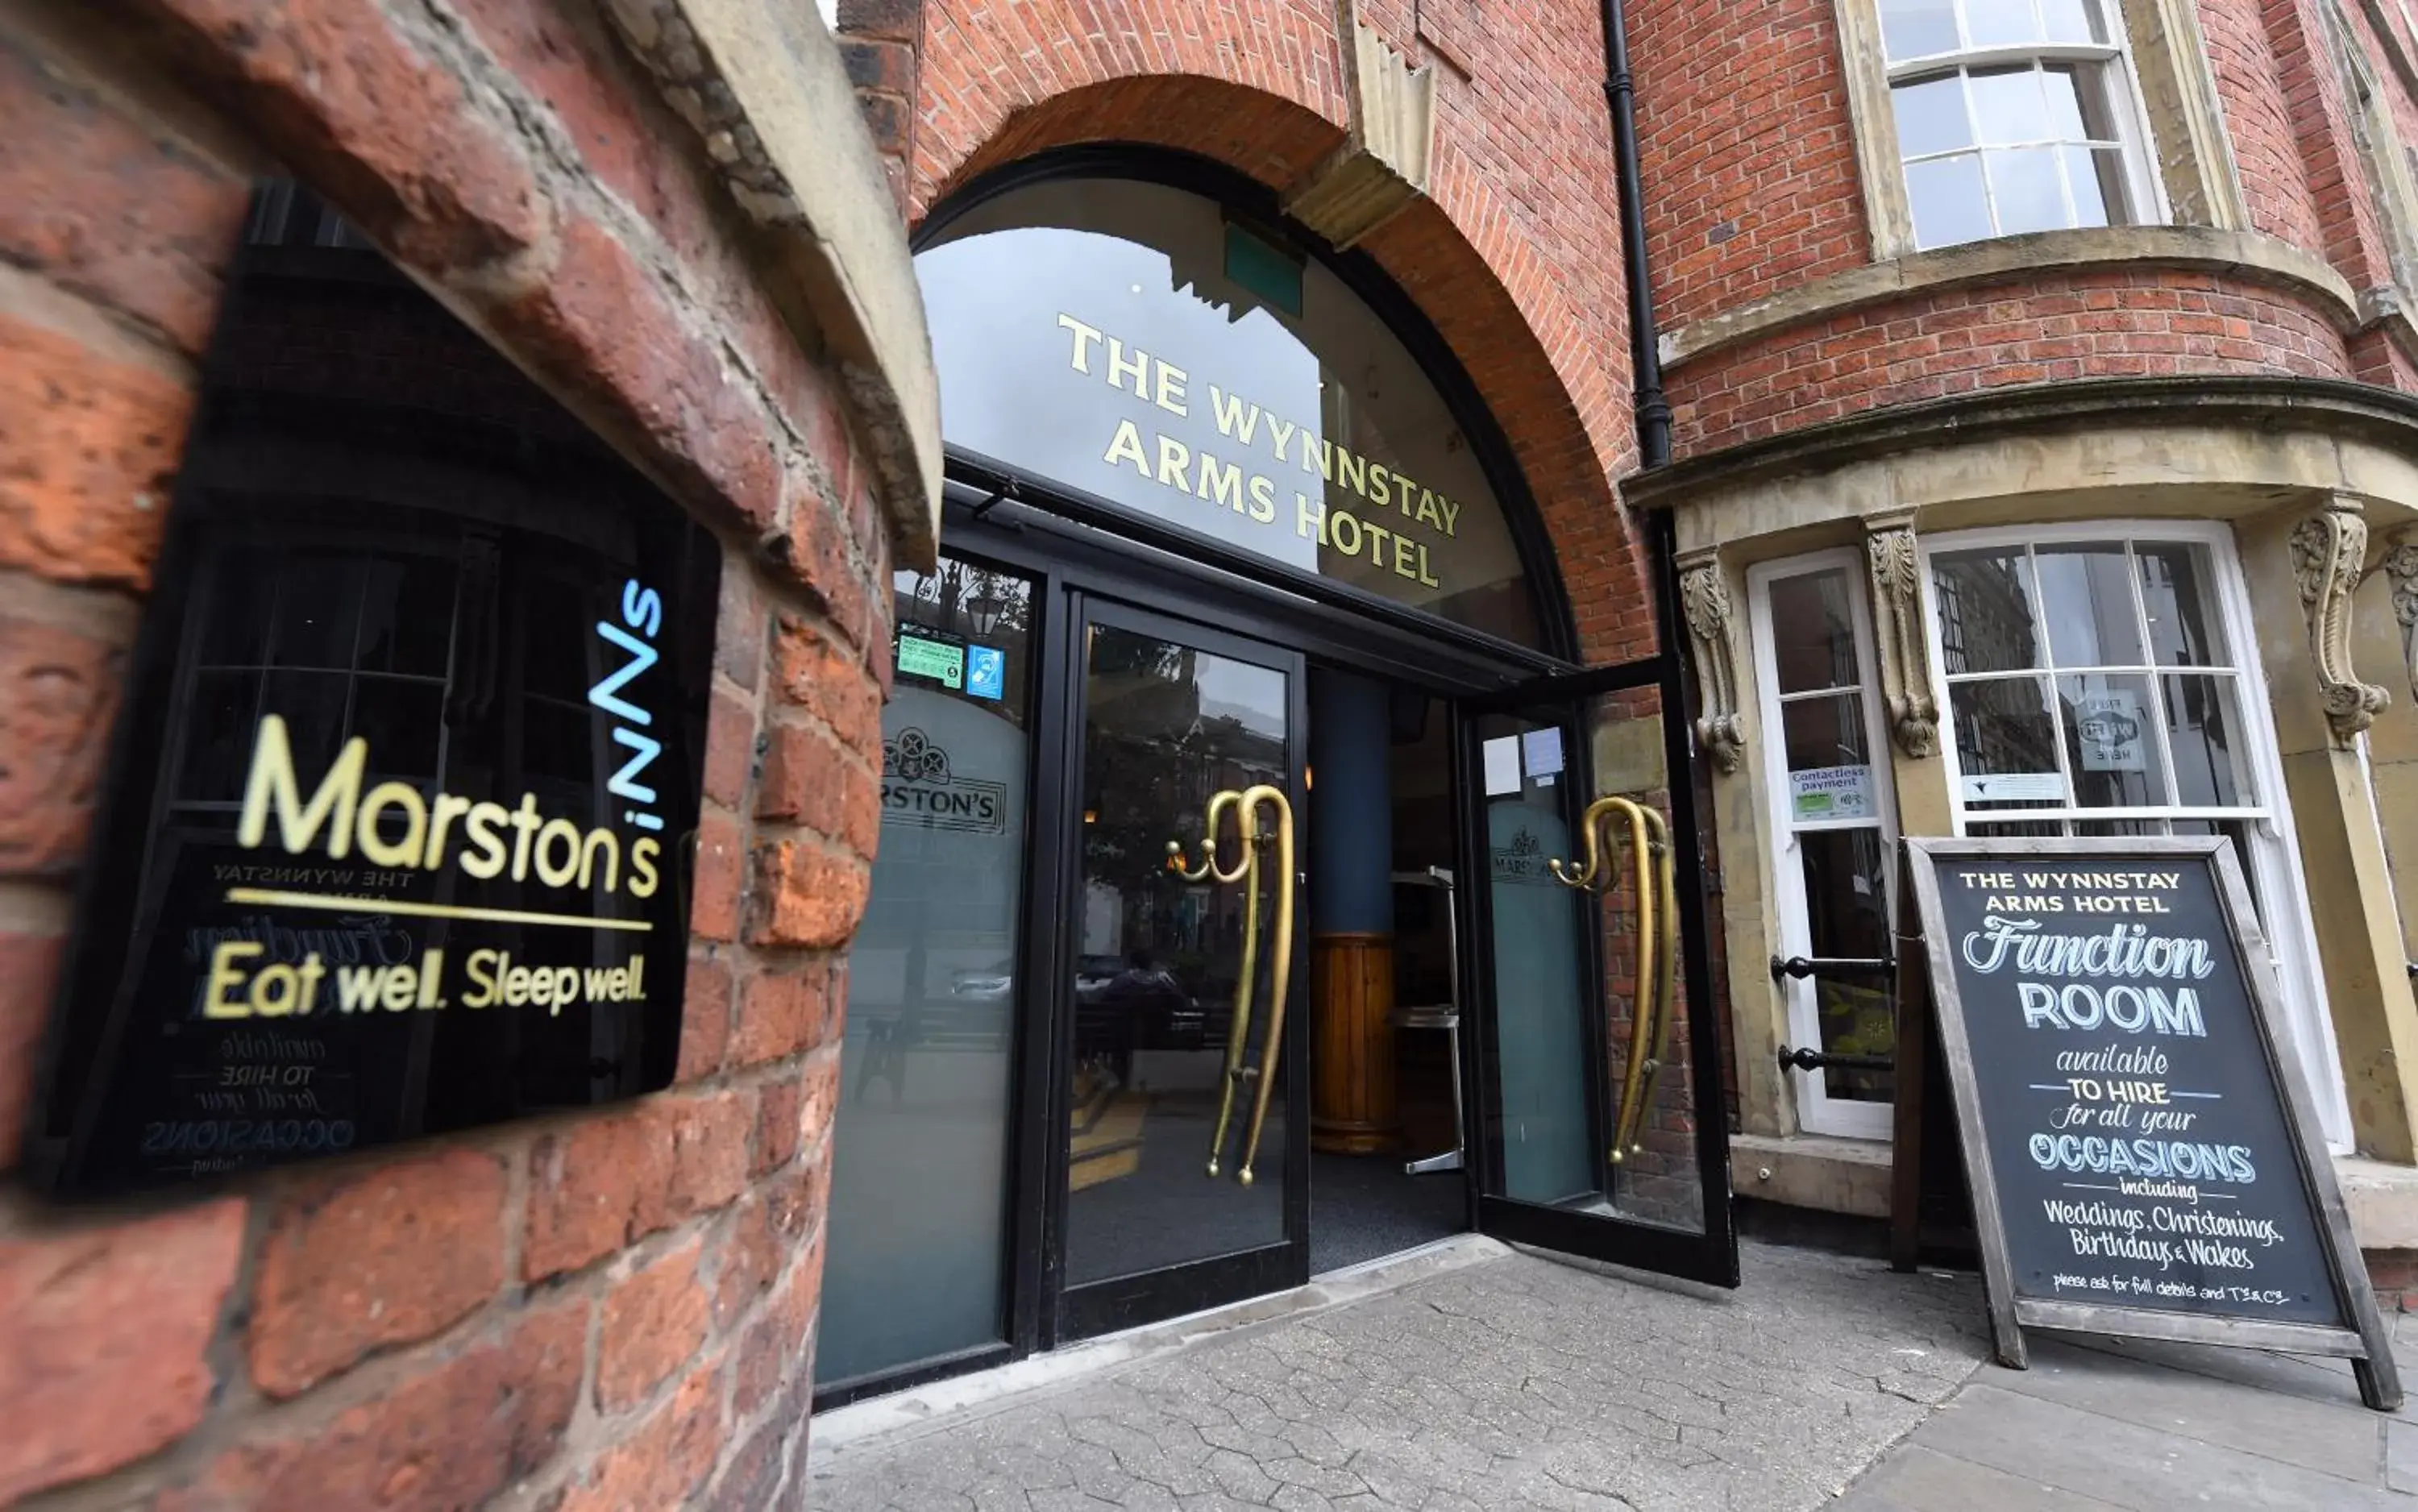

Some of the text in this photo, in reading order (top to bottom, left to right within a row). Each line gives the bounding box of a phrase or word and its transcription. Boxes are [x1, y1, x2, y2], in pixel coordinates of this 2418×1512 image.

[1057, 313, 1463, 538] THE WYNNSTAY
[1103, 419, 1440, 589] ARMS HOTEL
[1793, 768, 1864, 781] Contactless
[1801, 778, 1857, 791] payment
[881, 784, 995, 818] RSTON'S
[1960, 873, 2180, 889] THE WYNNSTAY
[1985, 895, 2171, 912] ARMS HOTEL
[1963, 915, 2215, 979] Function
[203, 941, 325, 1019] Eat
[462, 949, 580, 1017] Sleep
[584, 955, 647, 1003] well.
[2017, 982, 2207, 1036] ROOM
[2057, 1045, 2169, 1074] available
[2067, 1078, 2171, 1104] TO HIRE
[2050, 1103, 2196, 1135] for all your
[2029, 1132, 2256, 1183] OCCASIONS
[2119, 1177, 2198, 1204] including
[2153, 1205, 2285, 1246] Christenings,
[2070, 1227, 2255, 1270] Birthdays & Wakes
[2053, 1273, 2088, 1292] please
[2112, 1274, 2130, 1293] for
[2132, 1276, 2153, 1294] full
[2200, 1286, 2225, 1300] and
